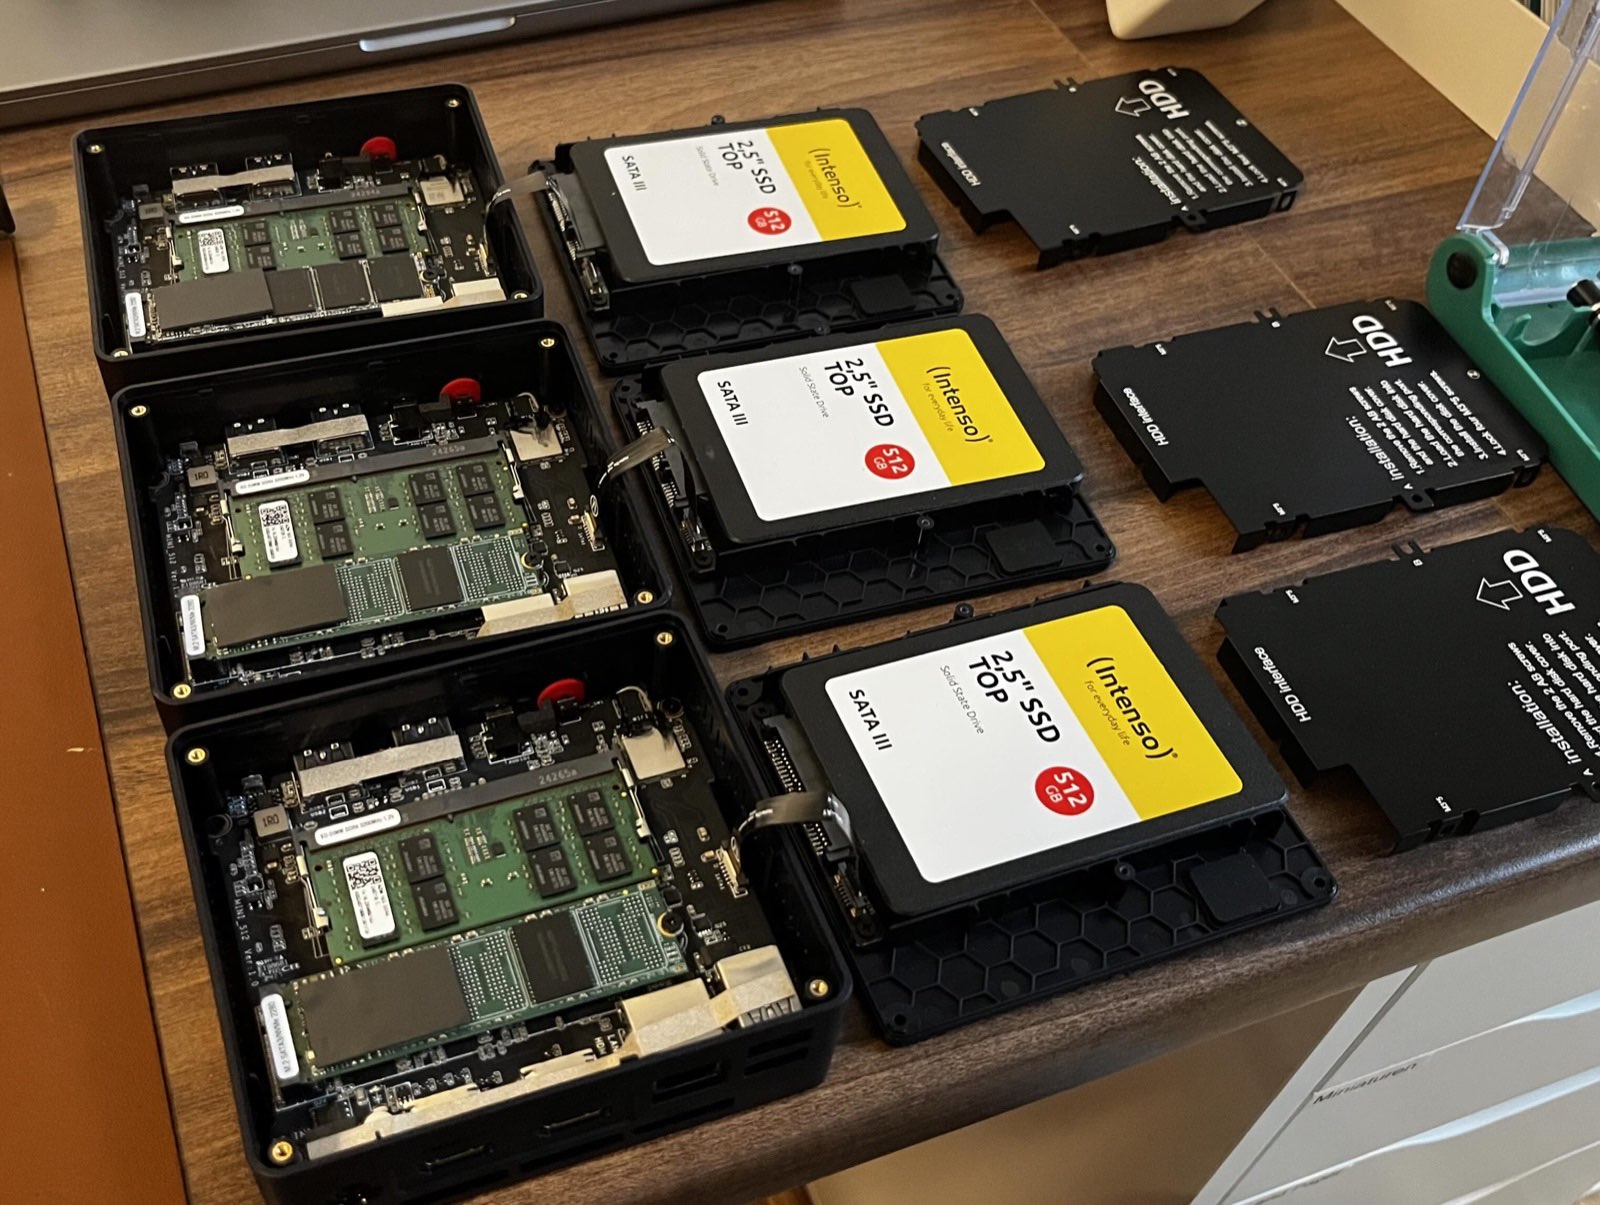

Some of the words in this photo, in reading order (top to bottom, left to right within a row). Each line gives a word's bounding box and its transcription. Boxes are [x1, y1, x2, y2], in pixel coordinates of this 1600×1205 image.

[1138, 79, 1189, 120] HDD
[718, 143, 743, 169] TOP
[622, 156, 640, 179] SATA
[634, 181, 646, 190] III
[751, 168, 776, 193] SSD
[962, 166, 980, 186] HDD
[764, 209, 785, 230] 512
[1352, 314, 1413, 368] HDD
[824, 362, 854, 396] TOP
[799, 366, 812, 382] Solid
[807, 382, 821, 400] State
[816, 400, 830, 418] Drive
[1392, 394, 1408, 409] disk
[718, 381, 740, 411] SATA
[732, 414, 748, 425] III
[864, 394, 894, 426] SSD
[1436, 403, 1452, 418] disk
[1367, 410, 1382, 421] AB
[1381, 407, 1396, 422] disk
[1404, 410, 1424, 428] hard
[1450, 418, 1463, 431] the
[1147, 424, 1168, 445] HDD
[1383, 428, 1396, 440] the
[1392, 422, 1410, 439] hard
[1421, 428, 1434, 440] the
[1408, 439, 1421, 451] the
[874, 457, 887, 470] GB
[883, 448, 908, 474] 512
[1503, 549, 1576, 616] HDD
[1543, 634, 1560, 651] into
[1508, 642, 1535, 672] screws
[1557, 651, 1577, 670] disk
[969, 656, 1008, 702] TOP
[1531, 673, 1548, 686] AB
[1546, 668, 1565, 686] disk
[1572, 672, 1596, 694] hard
[940, 666, 958, 686] Solid
[953, 687, 970, 709] State
[967, 711, 984, 734] Drive
[1285, 694, 1311, 722] HDD
[1552, 696, 1567, 710] the
[1560, 688, 1584, 709] hard
[849, 690, 880, 731] SATA
[873, 734, 892, 750] III
[1020, 698, 1060, 742] SSD
[1085, 680, 1097, 692] for
[1094, 695, 1121, 730] everyday
[1118, 731, 1130, 745] life
[1508, 681, 1581, 764] installation:
[1581, 710, 1597, 725] the
[1046, 786, 1063, 803] GB
[1054, 772, 1087, 807] 512
[262, 814, 280, 828] 1R0
